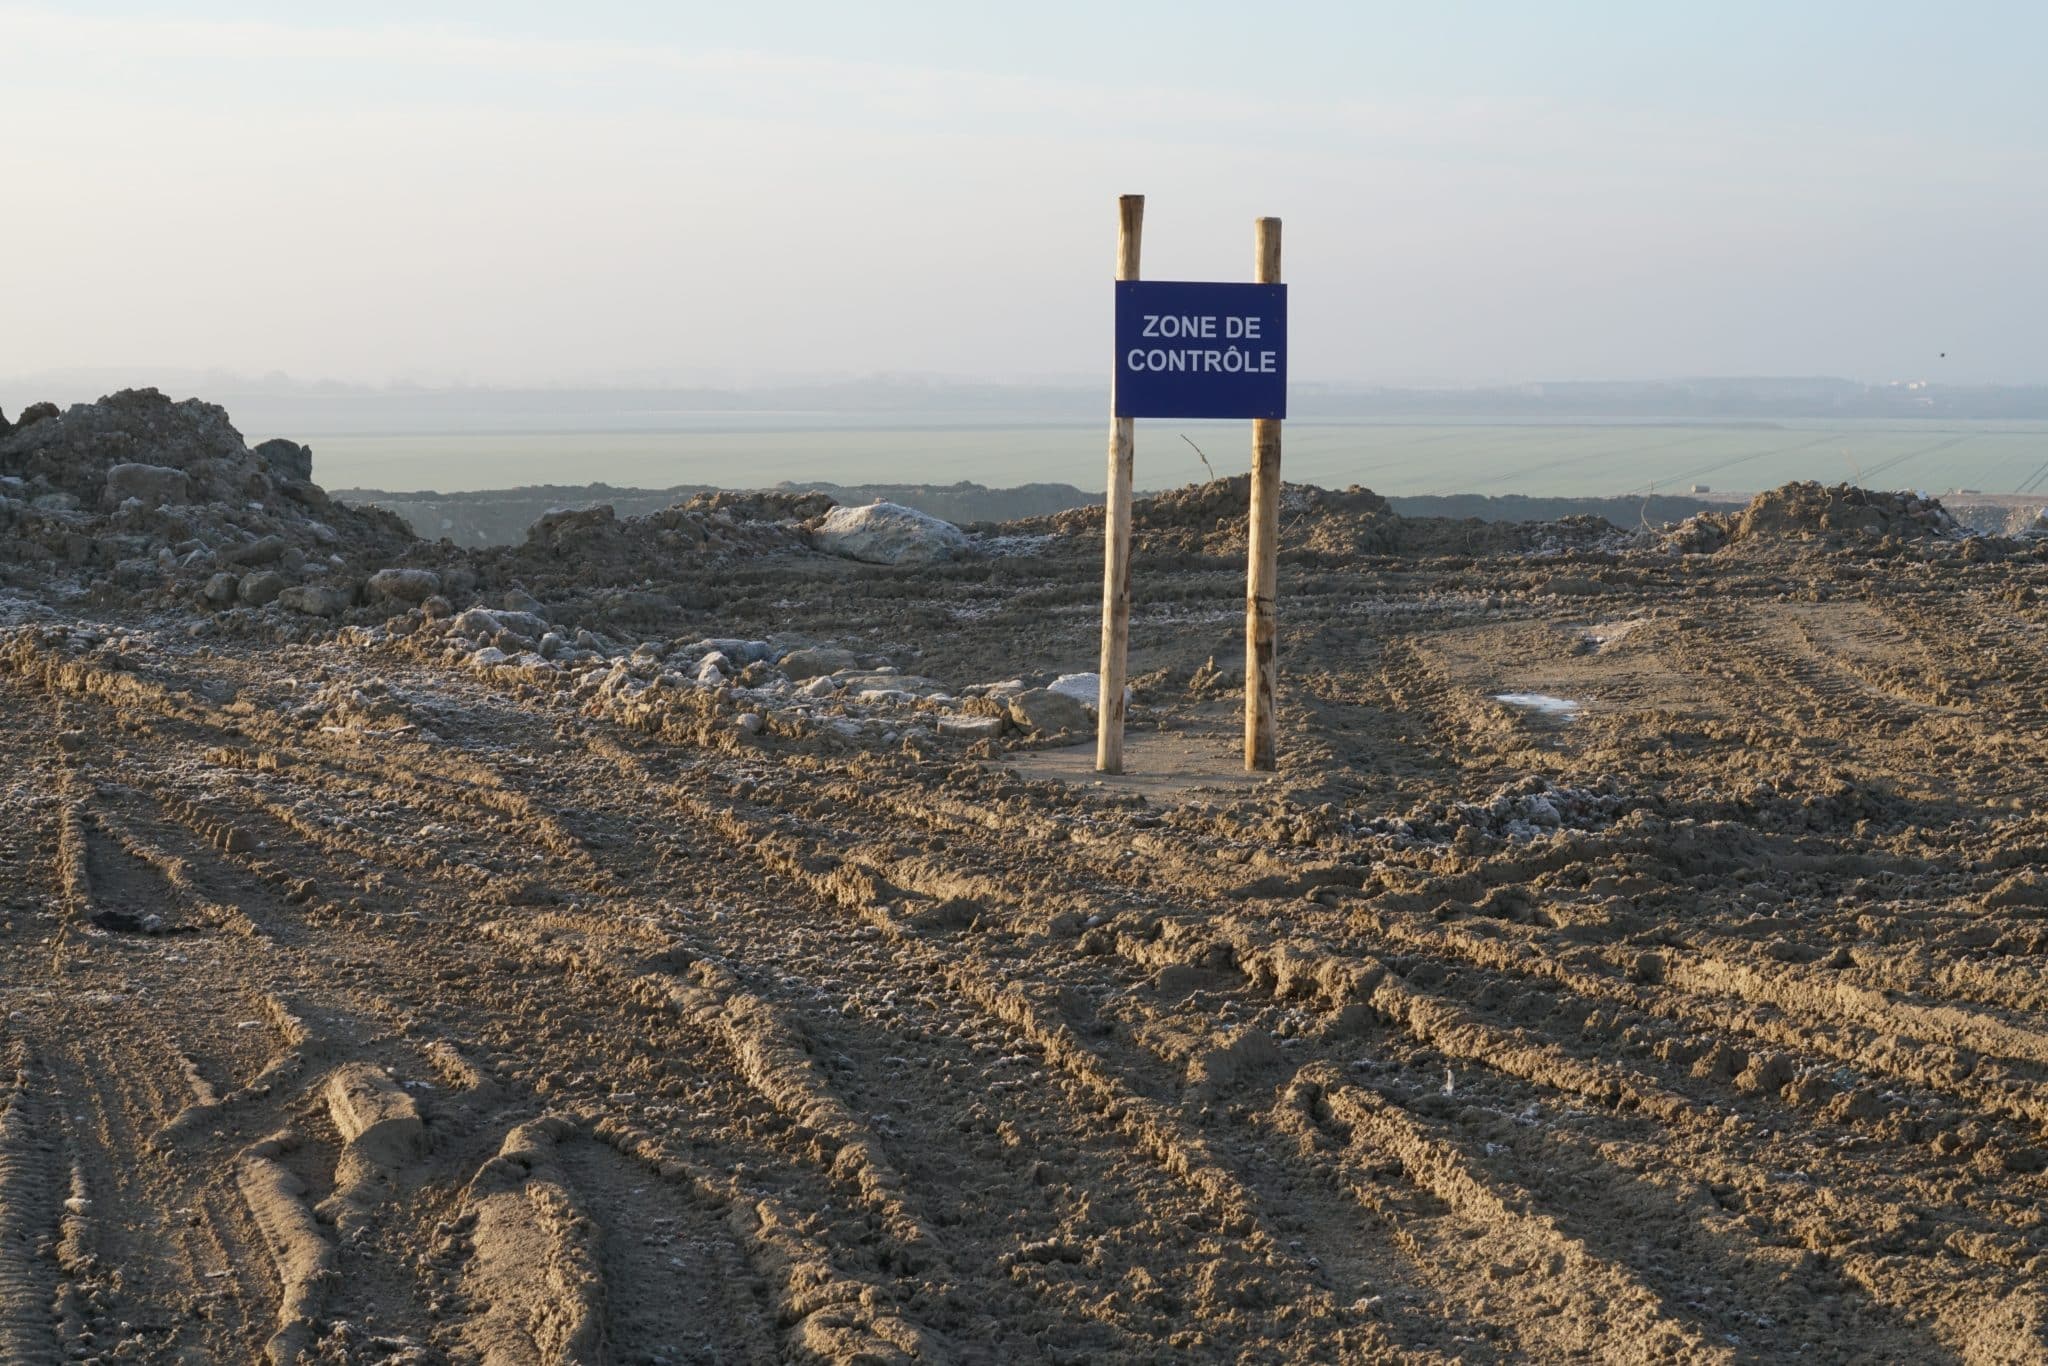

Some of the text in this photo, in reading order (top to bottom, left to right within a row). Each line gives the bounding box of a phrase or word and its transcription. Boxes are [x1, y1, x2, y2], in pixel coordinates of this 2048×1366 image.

[1142, 315, 1261, 339] ZONE DE
[1127, 345, 1276, 373] CONTRÔLE
